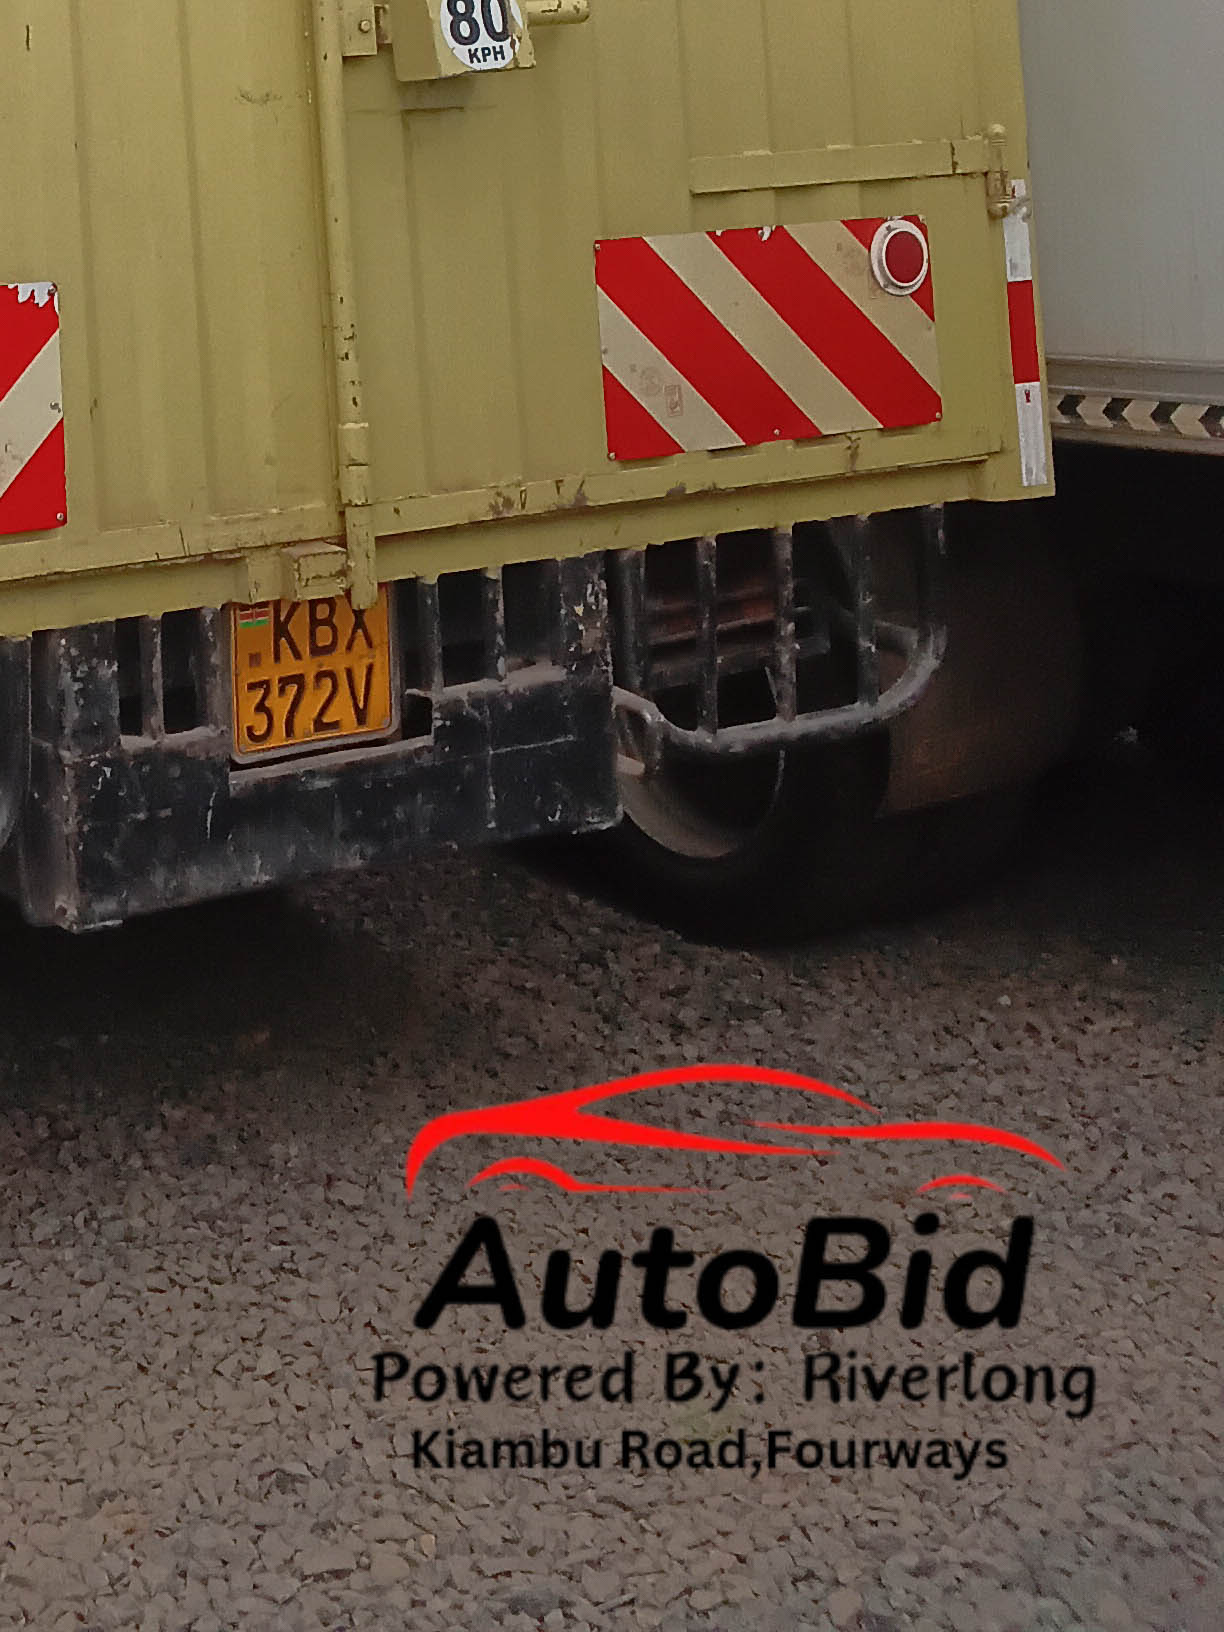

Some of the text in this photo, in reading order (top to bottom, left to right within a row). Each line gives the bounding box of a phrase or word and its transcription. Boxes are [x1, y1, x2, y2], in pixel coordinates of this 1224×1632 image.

[467, 45, 506, 64] KPH
[272, 588, 374, 664] KBX
[245, 663, 375, 744] 372V
